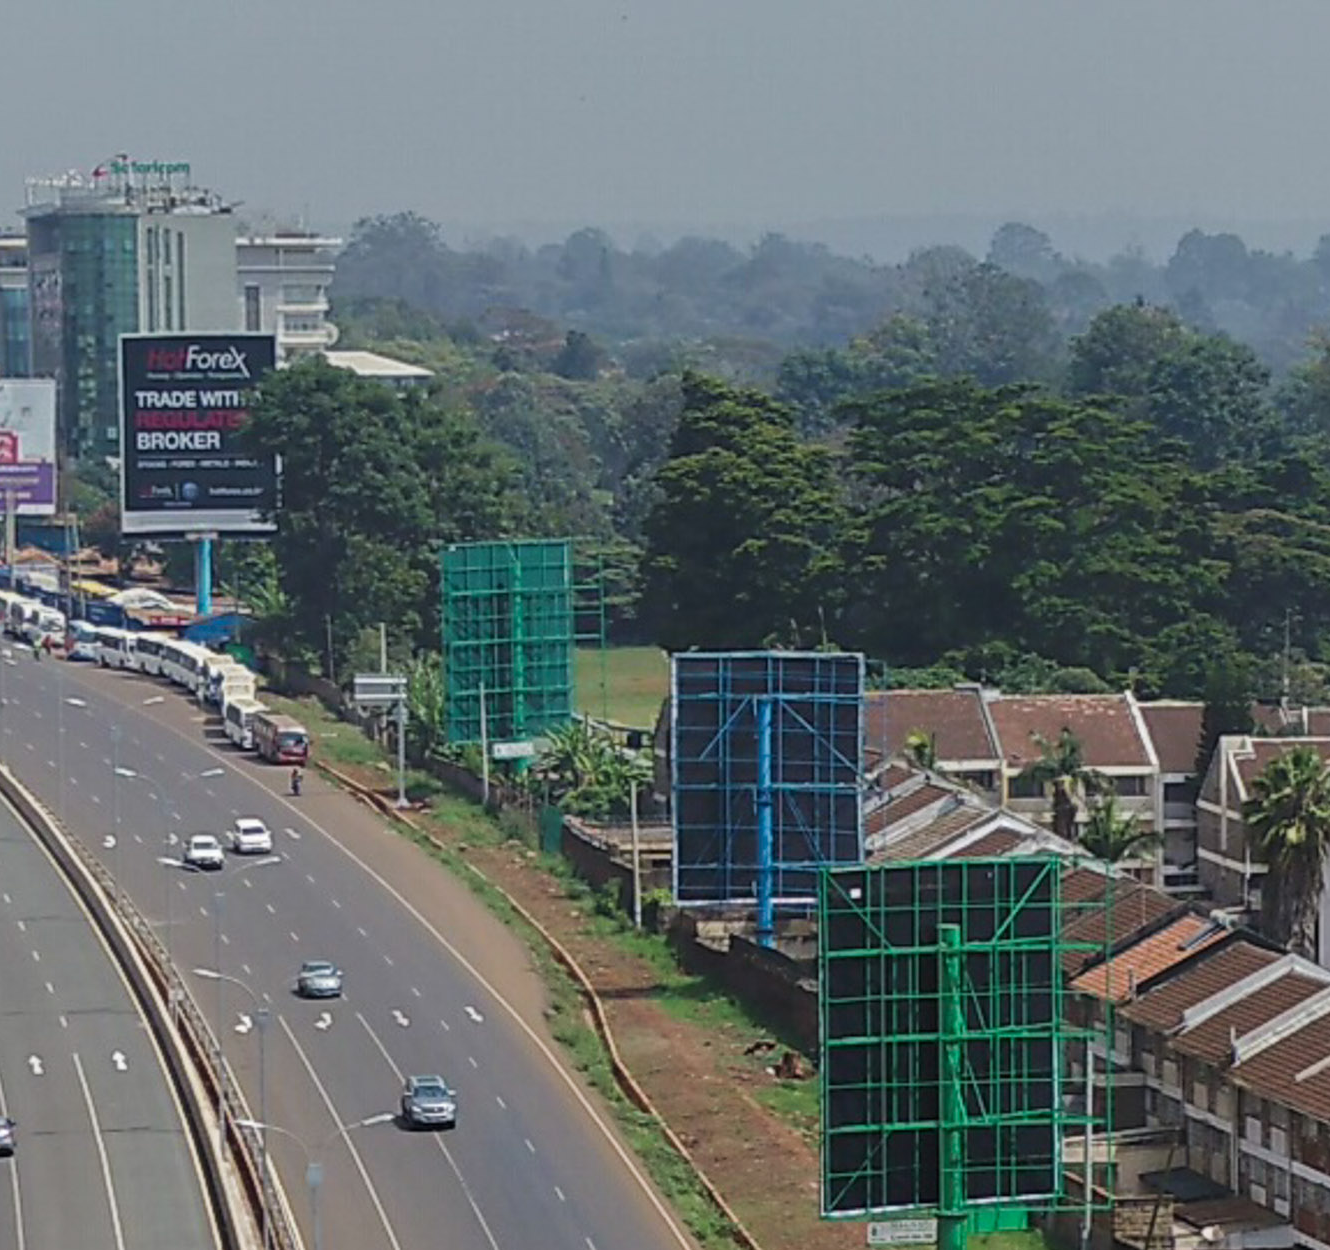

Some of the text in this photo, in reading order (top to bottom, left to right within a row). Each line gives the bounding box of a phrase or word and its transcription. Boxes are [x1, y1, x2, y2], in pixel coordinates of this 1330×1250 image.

[135, 390, 197, 408] TRADE
[135, 410, 248, 429] REGULATE
[137, 431, 221, 450] BROKER
